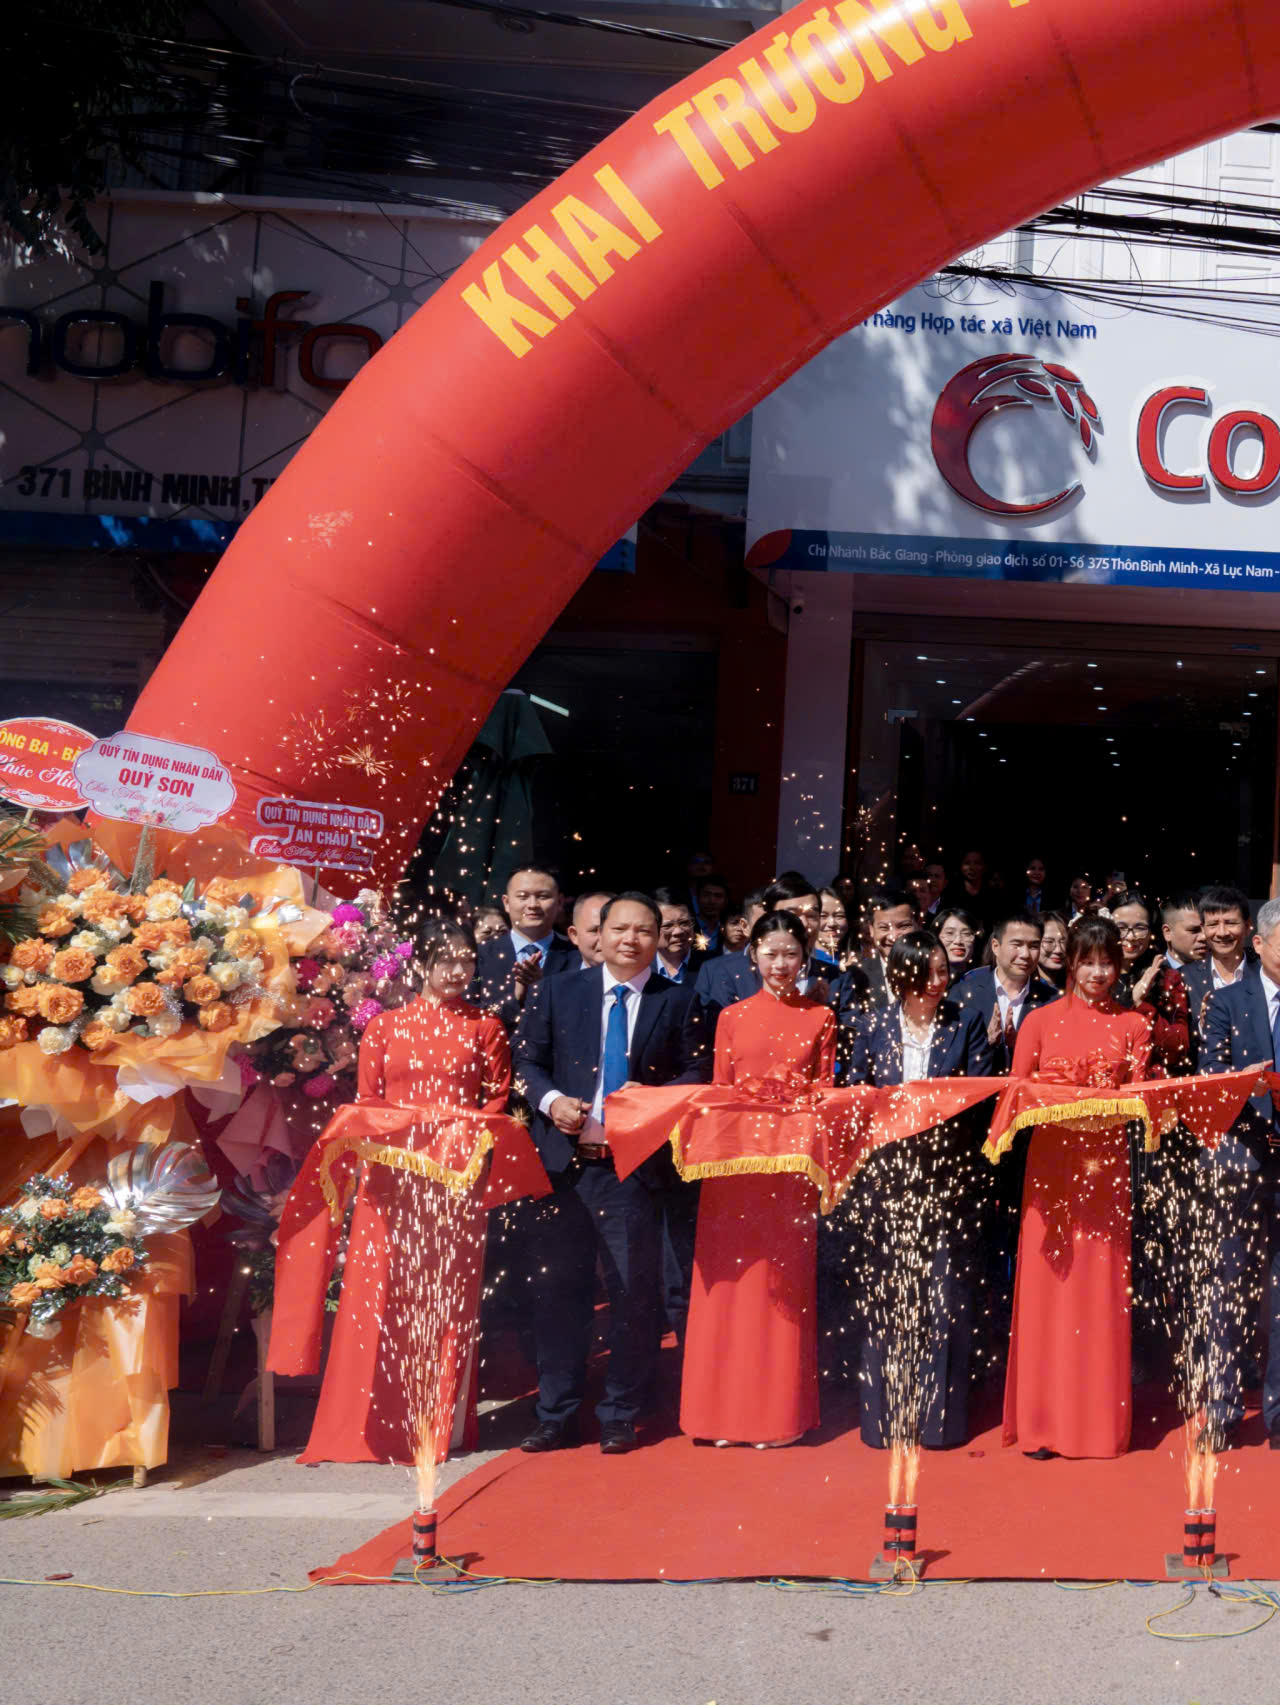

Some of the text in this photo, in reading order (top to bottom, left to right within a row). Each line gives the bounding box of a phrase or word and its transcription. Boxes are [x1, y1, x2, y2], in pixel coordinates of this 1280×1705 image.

[461, 164, 663, 359] KHAI
[0, 281, 388, 389] obifo
[921, 312, 954, 335] Hợp
[960, 315, 986, 334] tác
[992, 317, 1013, 334] xã
[1018, 317, 1051, 339] Việt
[1057, 320, 1097, 339] Nam
[17, 465, 72, 498] 371
[976, 553, 1001, 567] giao
[1004, 553, 1029, 567] dịch
[1032, 553, 1046, 567] số
[1087, 557, 1110, 569] 375
[1223, 564, 1242, 579] Lục
[28, 738, 49, 756] BA
[122, 747, 140, 763] TÍN
[140, 753, 170, 770] DỤNG
[171, 758, 200, 777] NHÂN
[201, 767, 223, 782] DÂN
[157, 776, 194, 798] SƠN
[296, 829, 348, 847] AN CHÂU
